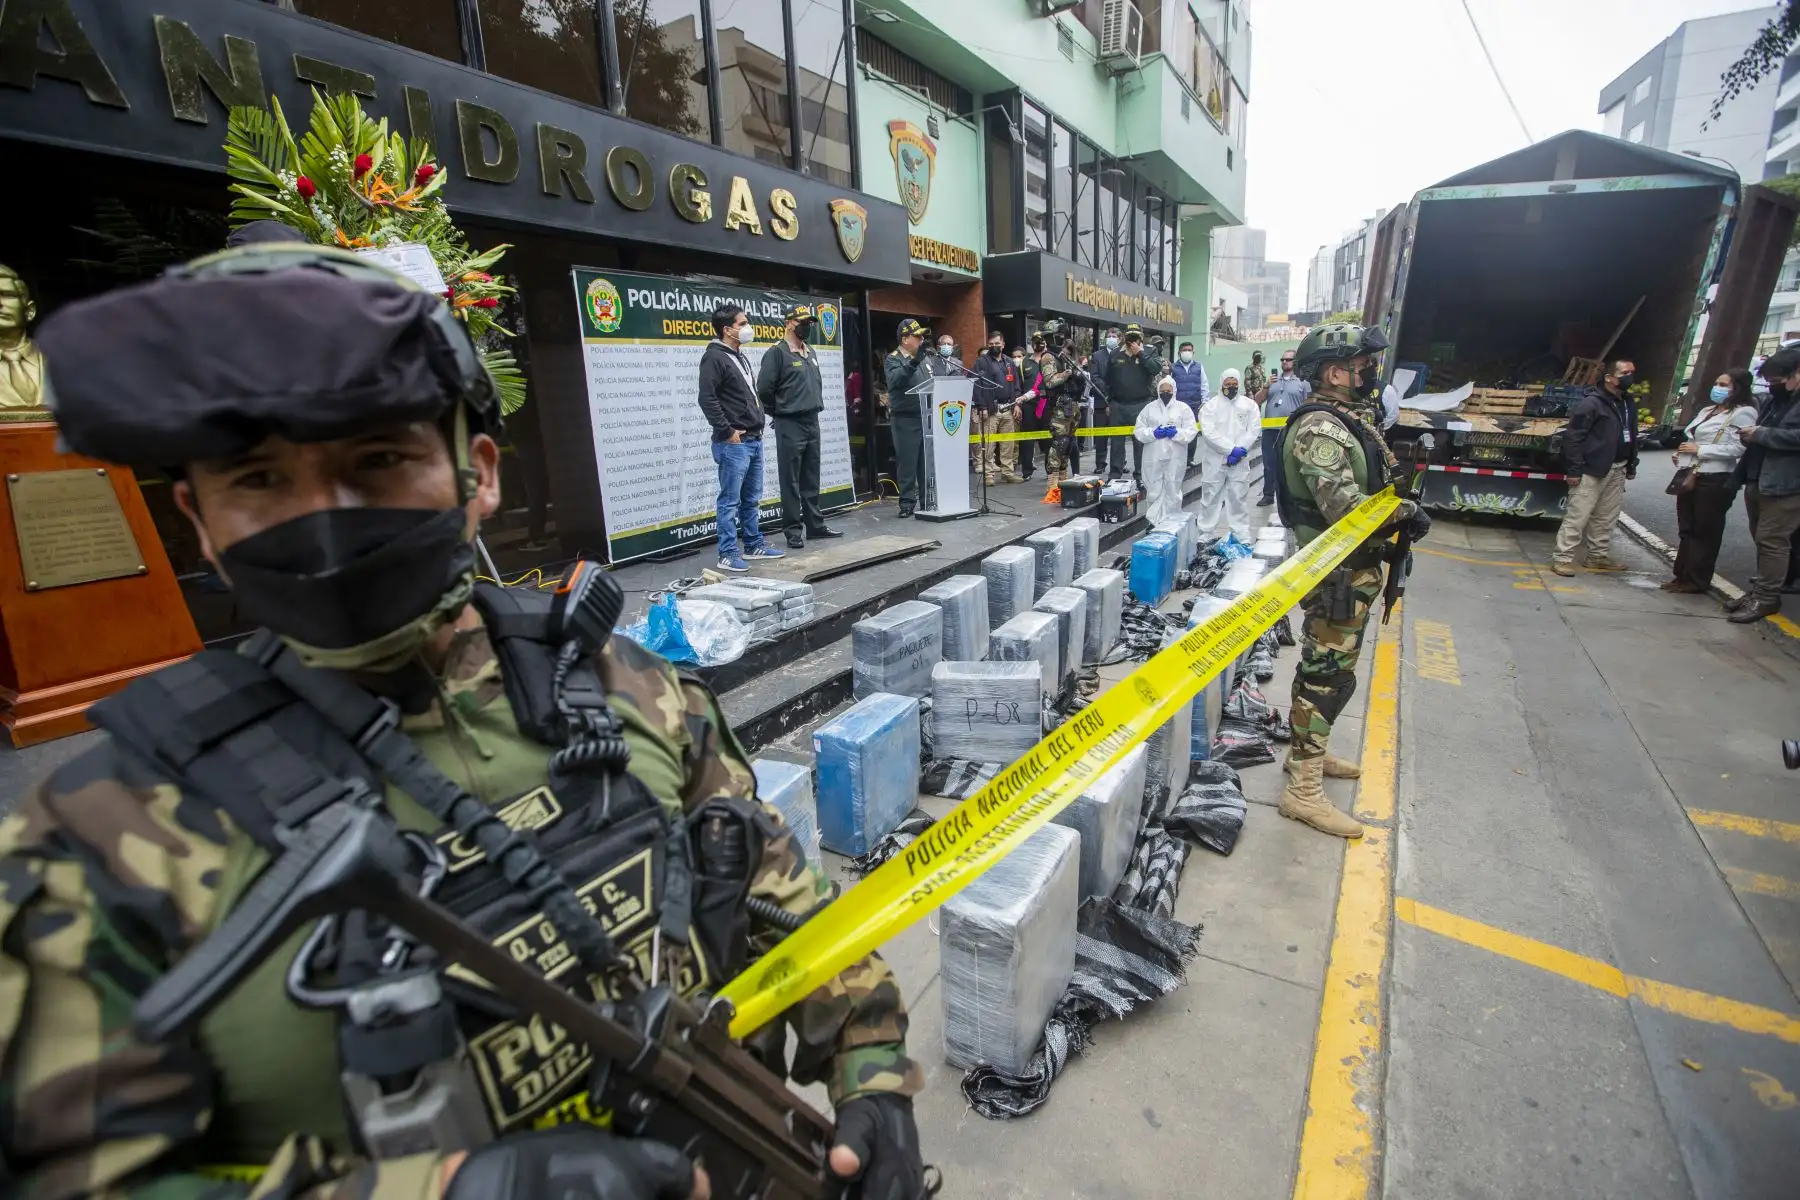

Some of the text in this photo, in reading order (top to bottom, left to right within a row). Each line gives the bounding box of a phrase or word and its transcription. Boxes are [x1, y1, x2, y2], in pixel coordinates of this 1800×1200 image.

[627, 288, 691, 311] POLICÍA
[762, 301, 785, 319] DEL
[1065, 271, 1118, 312] Trabajando
[1180, 628, 1211, 656] POLICIA
[1207, 607, 1241, 634] NACIONAL
[1188, 656, 1214, 677] ZONA
[905, 708, 1105, 877] POLICIA NACIONAL DEL PERU
